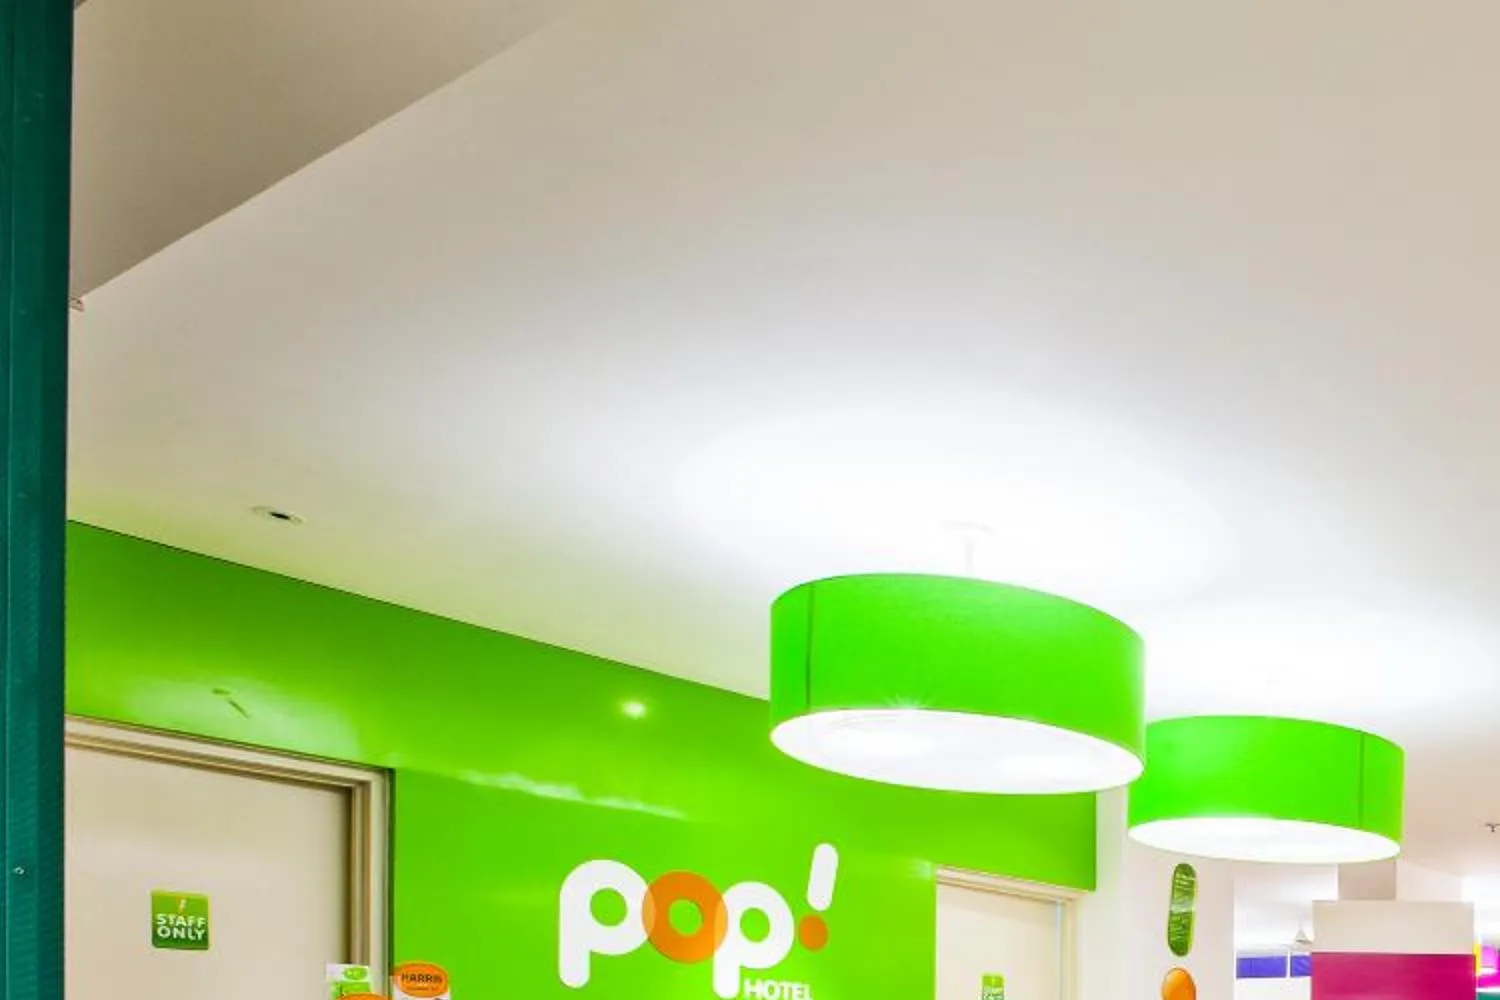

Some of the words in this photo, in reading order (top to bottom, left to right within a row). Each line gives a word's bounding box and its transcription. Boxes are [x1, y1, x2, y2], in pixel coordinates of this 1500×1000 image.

[156, 913, 206, 928] STAFF
[559, 843, 839, 999] pop!
[157, 926, 205, 940] ONLY
